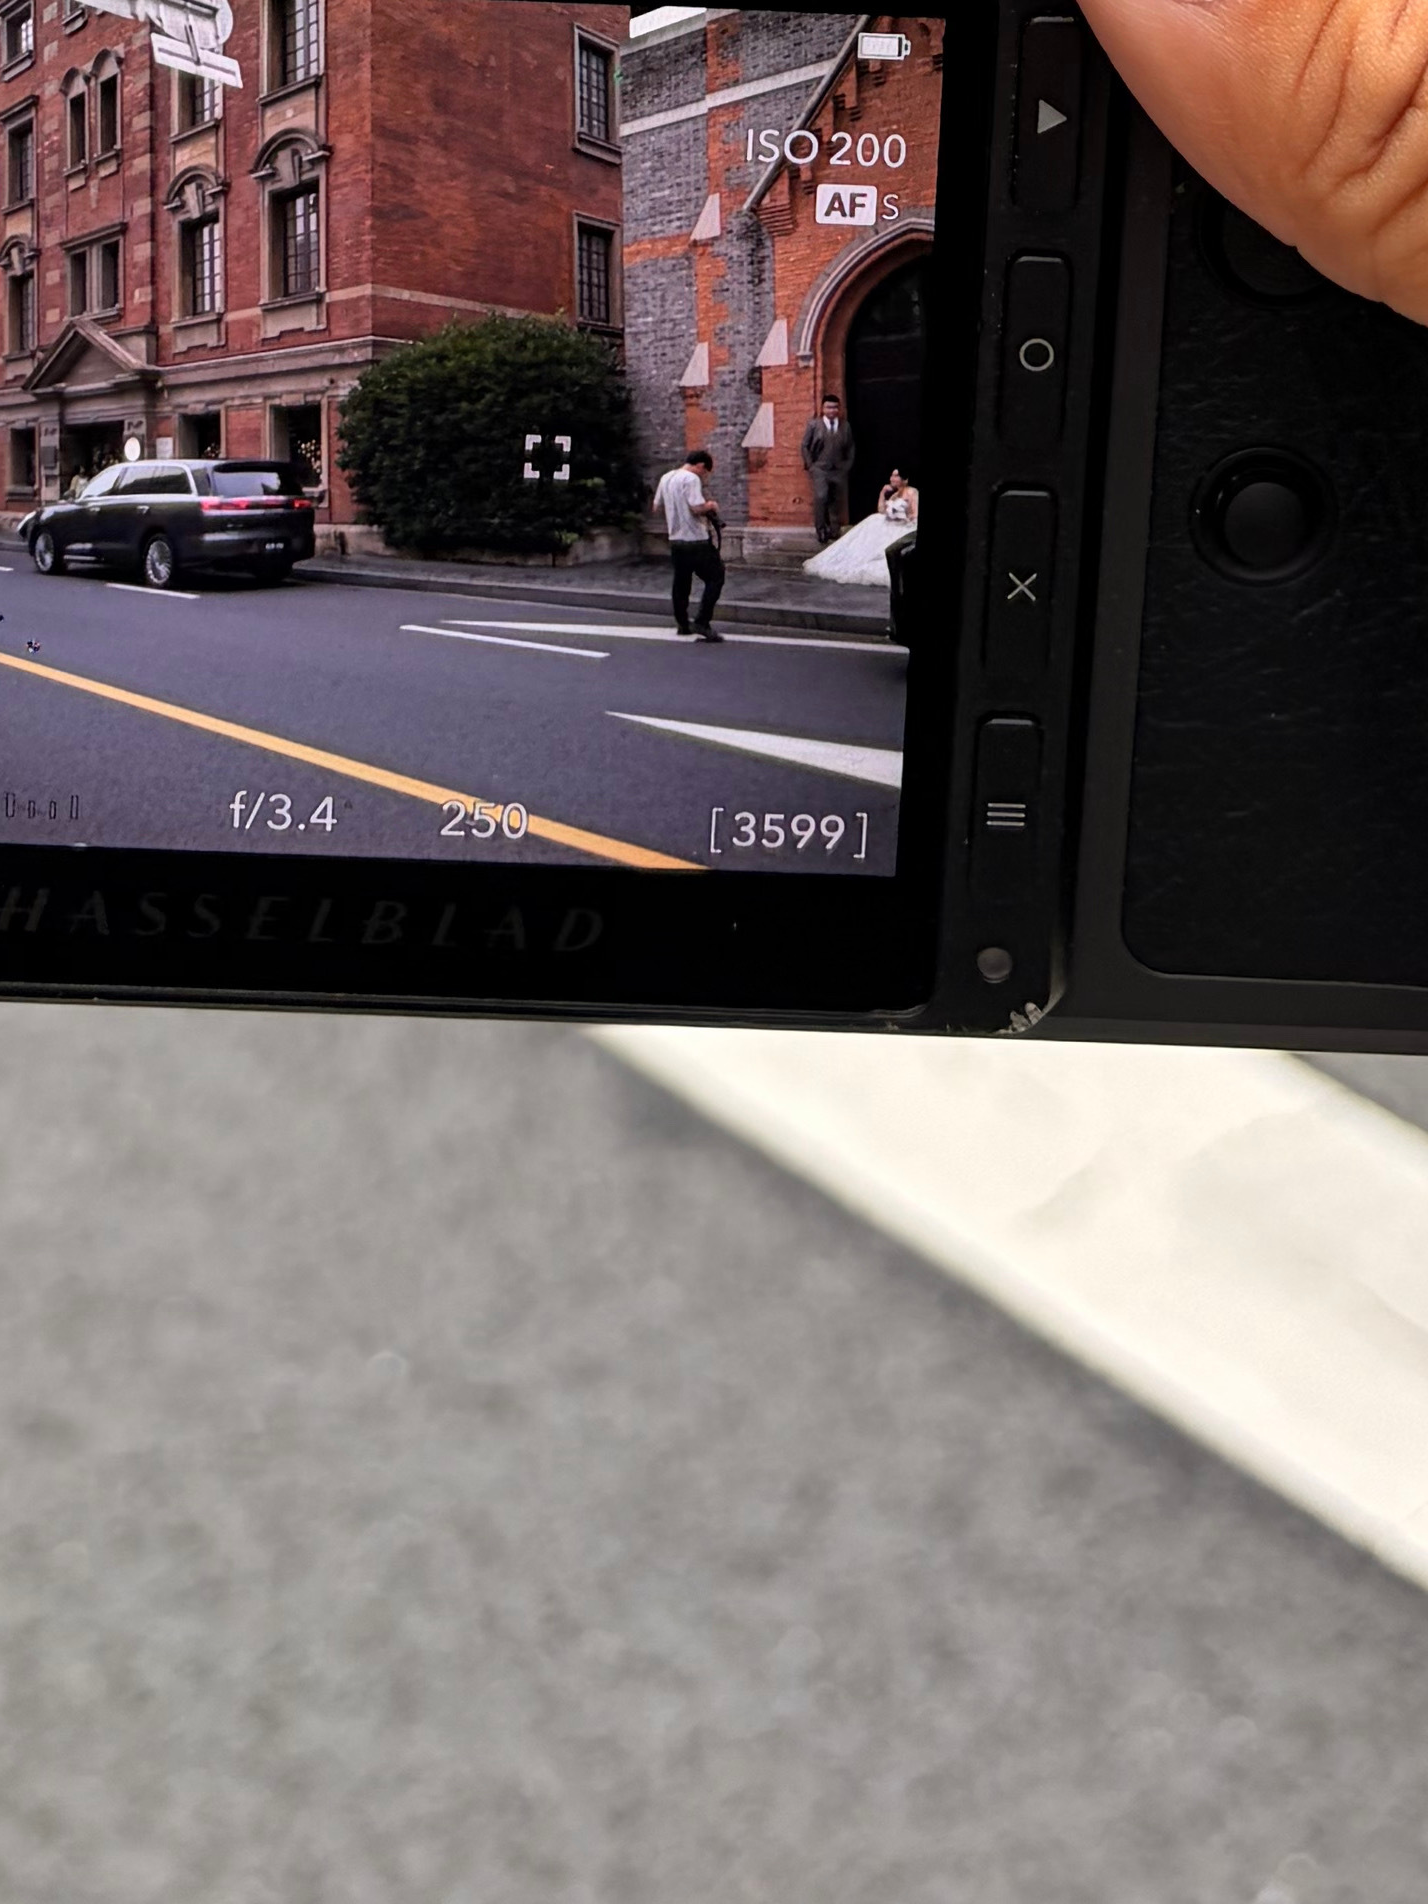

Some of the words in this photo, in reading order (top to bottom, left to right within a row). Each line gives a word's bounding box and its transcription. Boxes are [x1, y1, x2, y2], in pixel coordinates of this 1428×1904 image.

[745, 128, 820, 165] ISO
[828, 130, 908, 169] 200
[823, 191, 868, 219] AF
[881, 193, 900, 221] S
[228, 789, 338, 832] f/3.4
[439, 799, 530, 840] 250
[709, 806, 869, 860] [3599]
